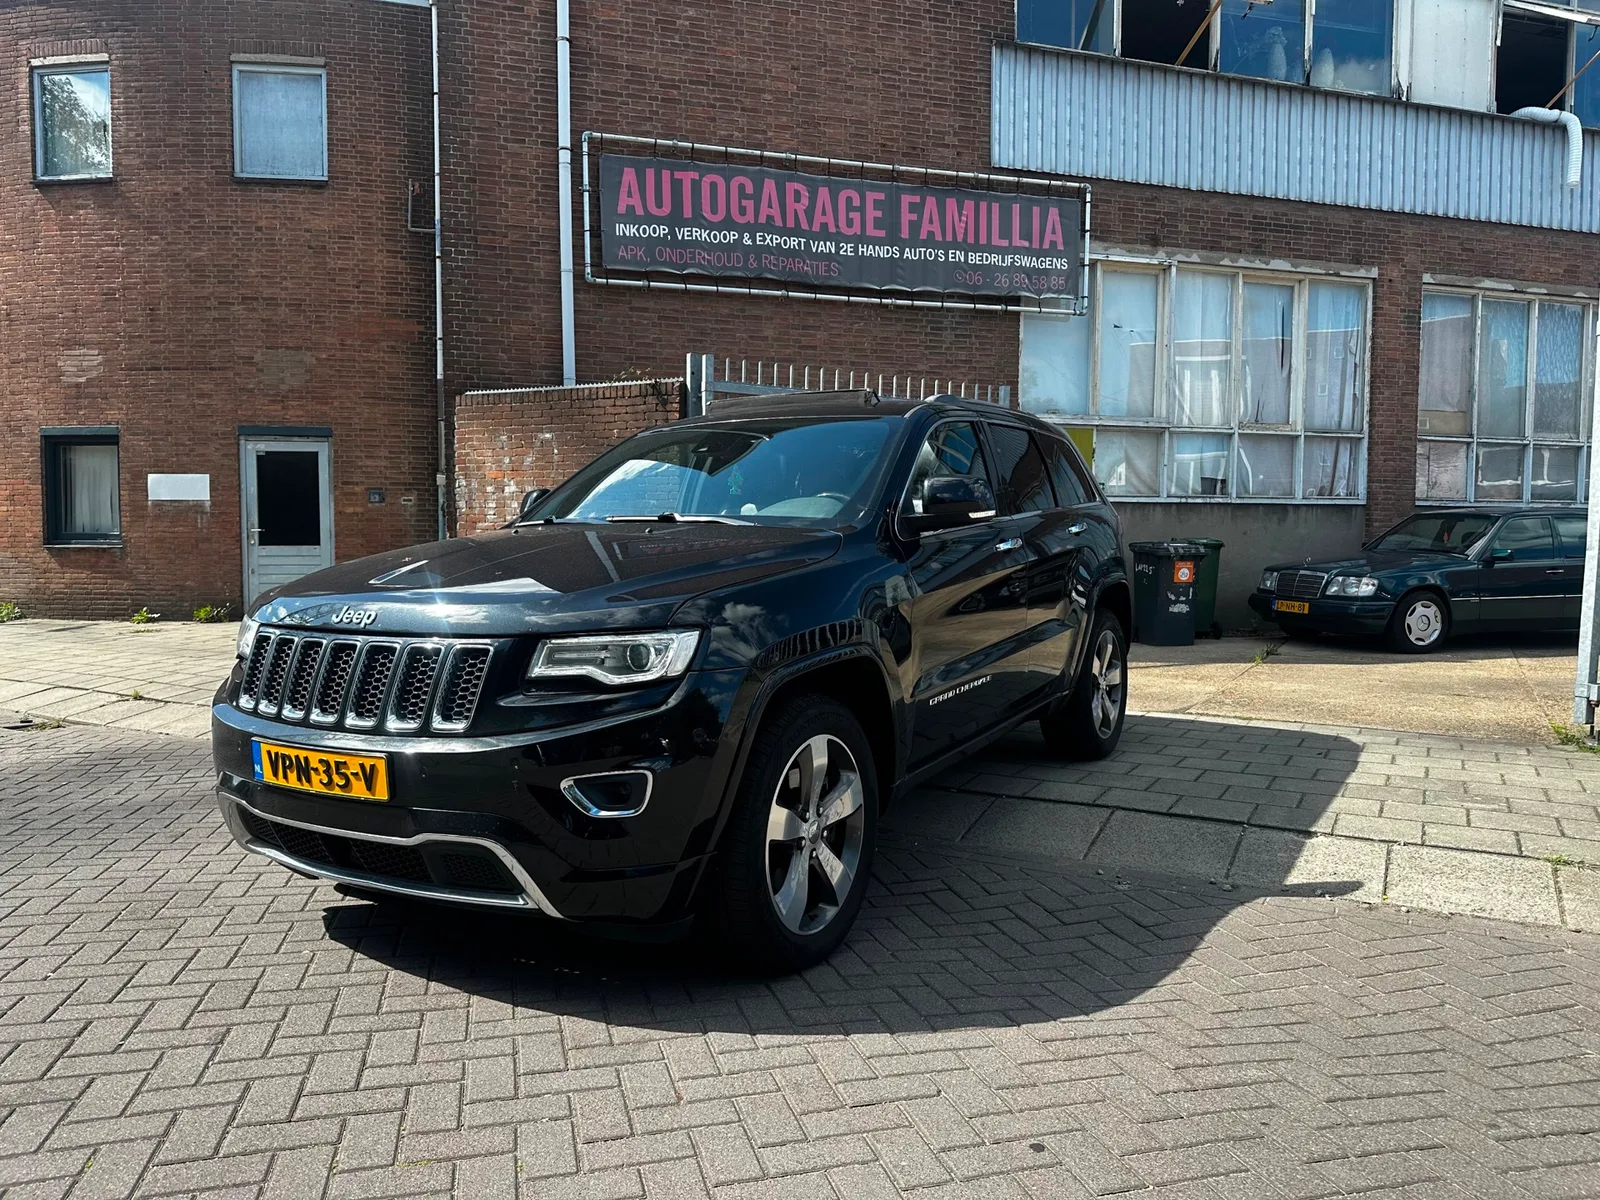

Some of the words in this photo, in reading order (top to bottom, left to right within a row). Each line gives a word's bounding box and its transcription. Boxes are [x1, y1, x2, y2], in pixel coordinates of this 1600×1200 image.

[617, 167, 886, 237] AUTOGARAGE
[900, 194, 1064, 250] FAMILLIA
[615, 223, 671, 240] INKOOP,
[675, 227, 738, 244] VERKOOP
[742, 232, 753, 245] &
[756, 232, 806, 251] EXPORT
[809, 240, 836, 254] VAN
[840, 243, 855, 256] 2E
[858, 244, 900, 258] HANDS
[903, 247, 945, 262] AUTO'S
[948, 250, 965, 264] EN
[968, 252, 1068, 270] BEDRIJFSWAGENS
[618, 245, 650, 263] APK,
[655, 246, 744, 267] ONDERHOUD
[748, 254, 758, 269] &
[762, 254, 839, 277] REPARATIES
[966, 271, 983, 286] 06
[994, 273, 1009, 287] 26
[1032, 276, 1047, 290] 58
[1050, 276, 1066, 290] 85
[331, 605, 377, 628] Jeep
[929, 689, 956, 706] GRAND
[254, 763, 263, 774] NL
[266, 750, 375, 792] VPN-35-V
